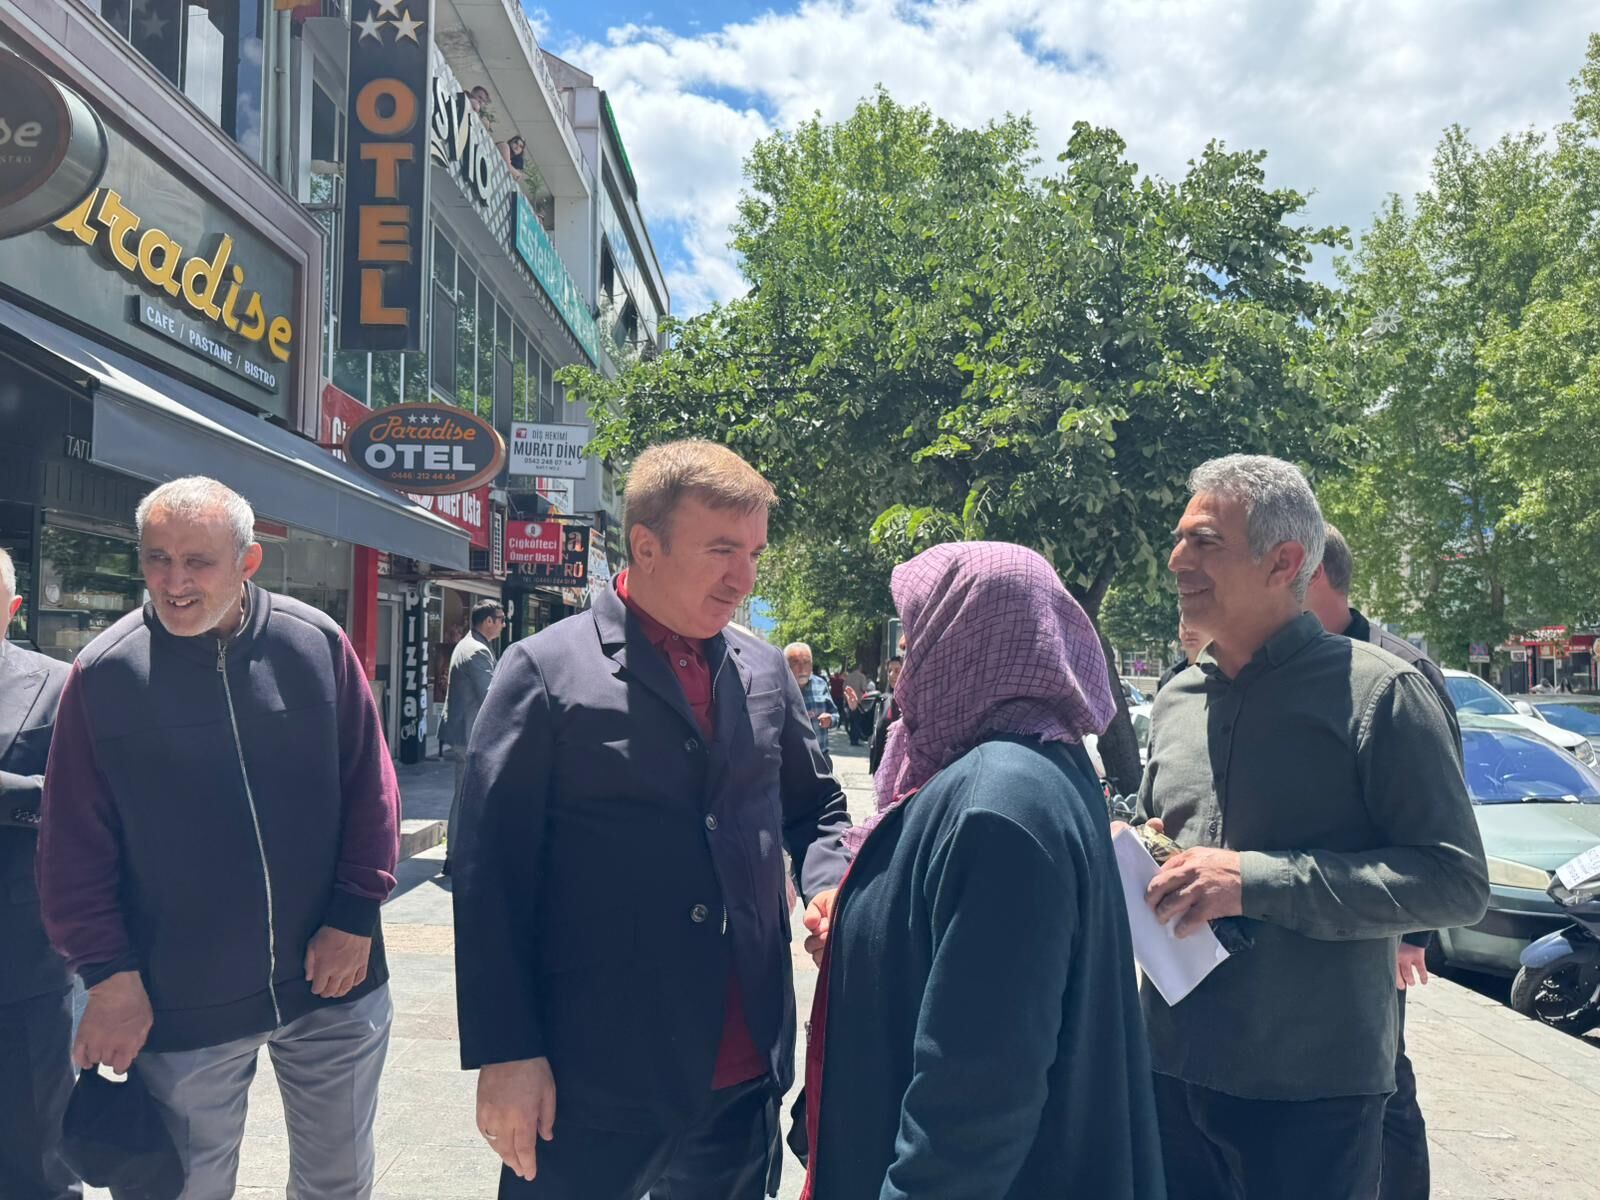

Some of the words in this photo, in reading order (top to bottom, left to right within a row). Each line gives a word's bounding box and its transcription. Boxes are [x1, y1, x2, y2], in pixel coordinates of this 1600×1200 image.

[356, 78, 417, 327] OTEL
[146, 305, 176, 334] CAFE
[188, 329, 233, 366] PASTANE
[244, 359, 276, 389] BISTRO
[369, 415, 477, 442] Paradise
[364, 443, 476, 471] OTEL
[513, 440, 555, 458] MURAT
[462, 491, 481, 528] Usta
[535, 552, 555, 563] Usta
